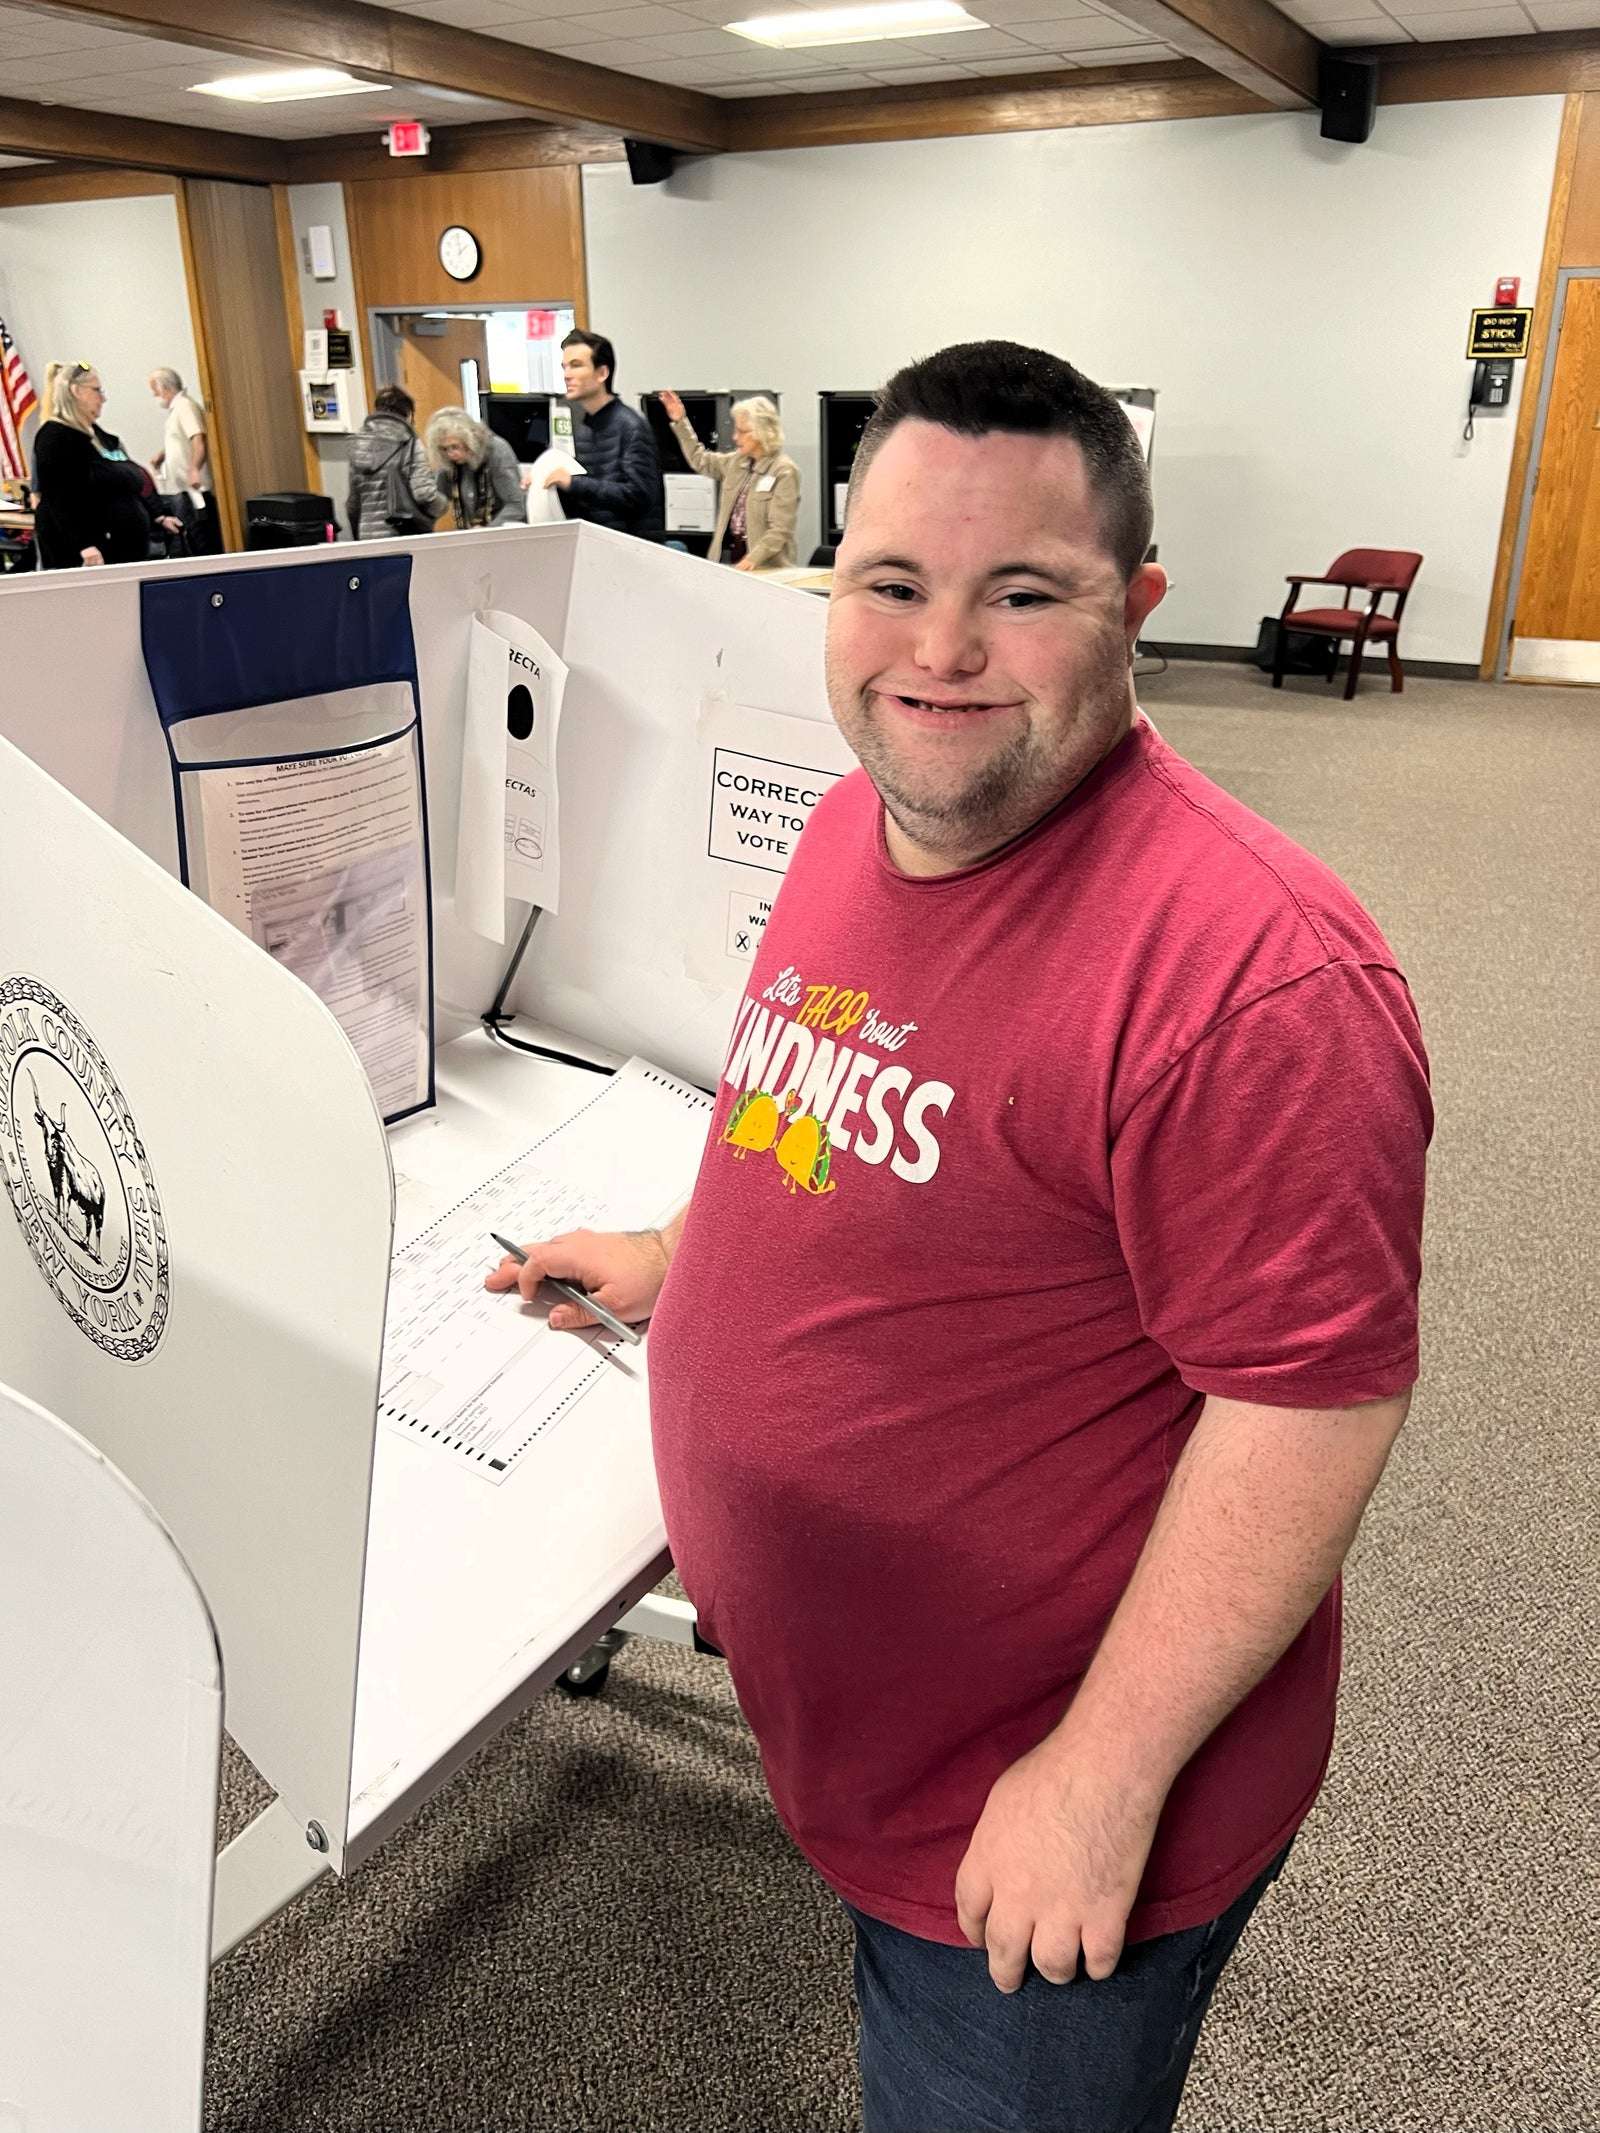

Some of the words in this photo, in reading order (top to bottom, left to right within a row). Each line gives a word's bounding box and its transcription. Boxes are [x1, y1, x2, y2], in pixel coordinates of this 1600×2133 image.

[1481, 328, 1516, 339] STICK
[276, 762, 297, 772] MAKE
[298, 759, 317, 769] SURE
[729, 802, 774, 825] WAY
[778, 814, 804, 832] TO
[737, 831, 788, 855] VOTE
[762, 966, 803, 1006] Let's
[795, 984, 870, 1035] TACO
[41, 1014, 137, 1168] COUNTY
[128, 1186, 154, 1292] SEAL
[11, 1176, 66, 1279] NEW
[72, 1276, 142, 1333] YORK
[69, 1235, 129, 1287] INDEPENDENCE
